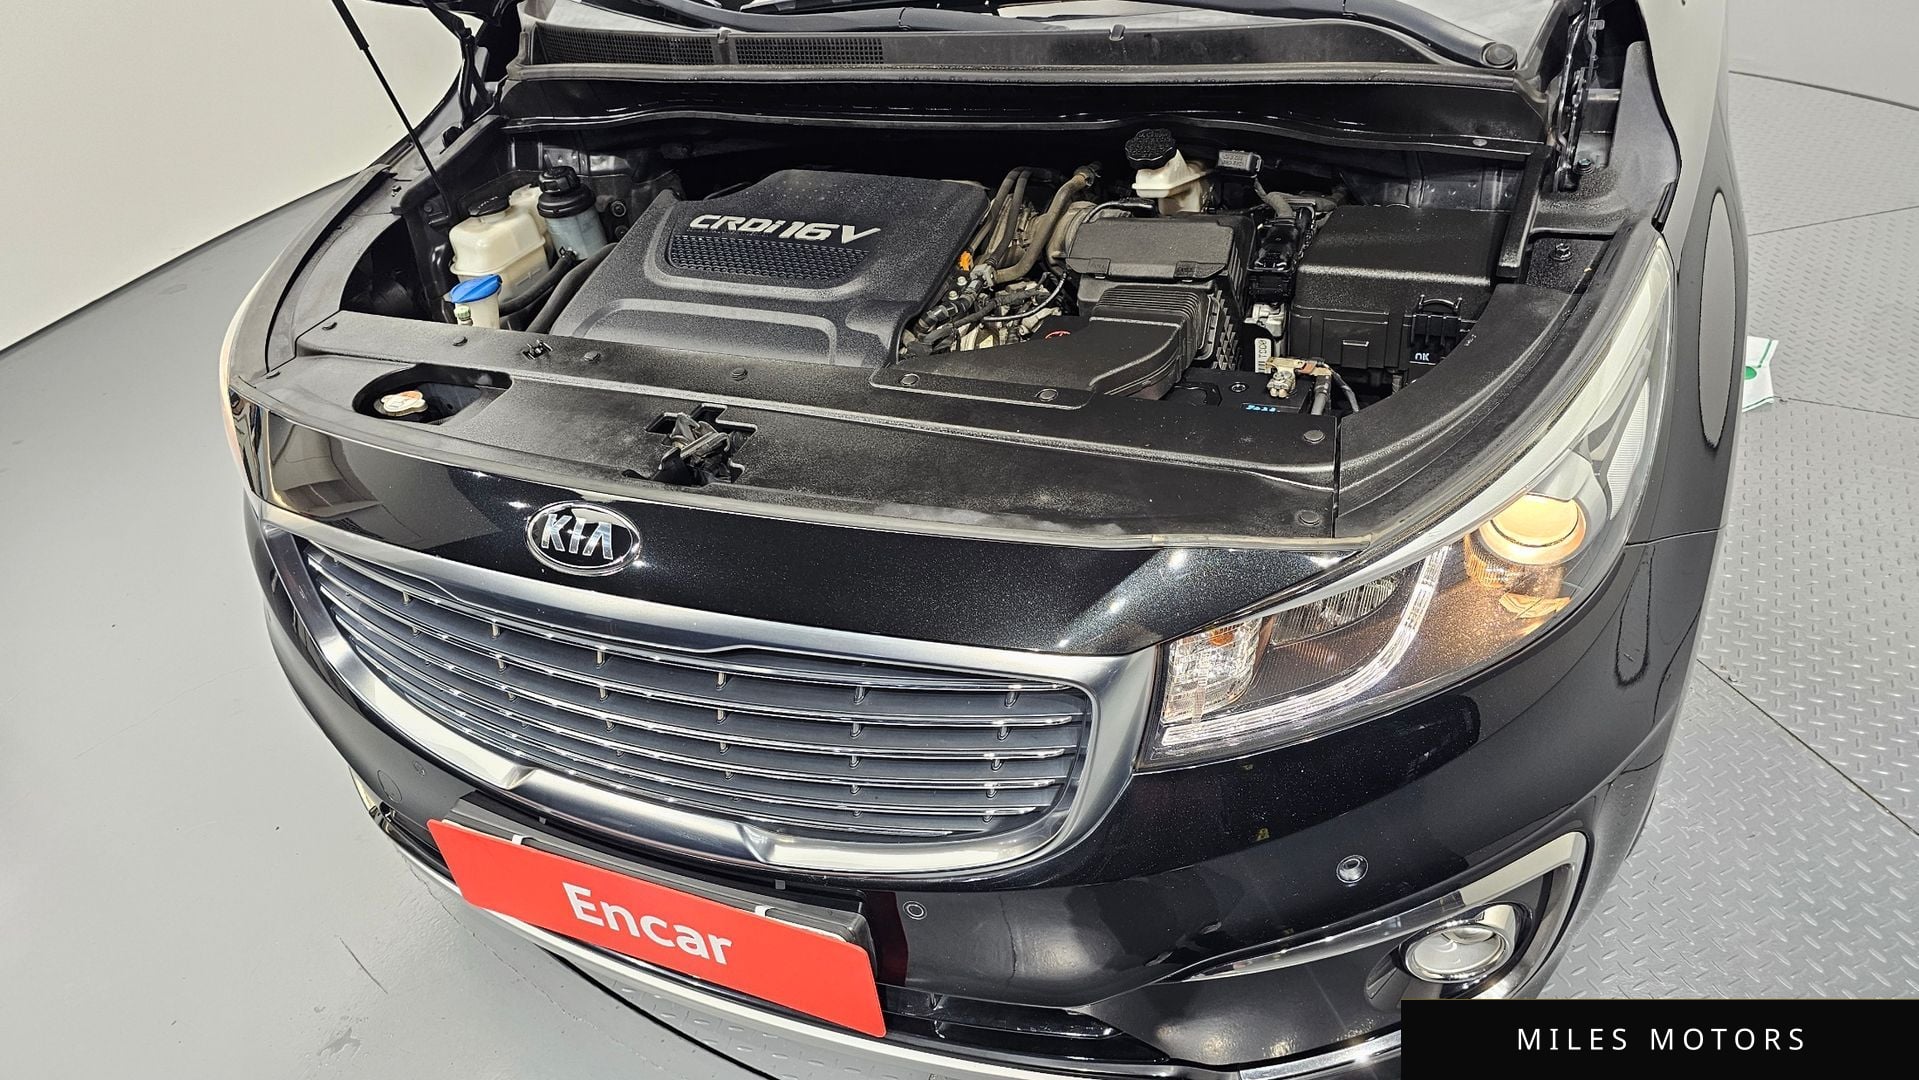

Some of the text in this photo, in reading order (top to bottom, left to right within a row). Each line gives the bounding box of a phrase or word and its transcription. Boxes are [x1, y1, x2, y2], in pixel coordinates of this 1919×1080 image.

[1414, 352, 1430, 362] OK
[541, 513, 614, 560] KIA
[562, 882, 732, 965] Encar
